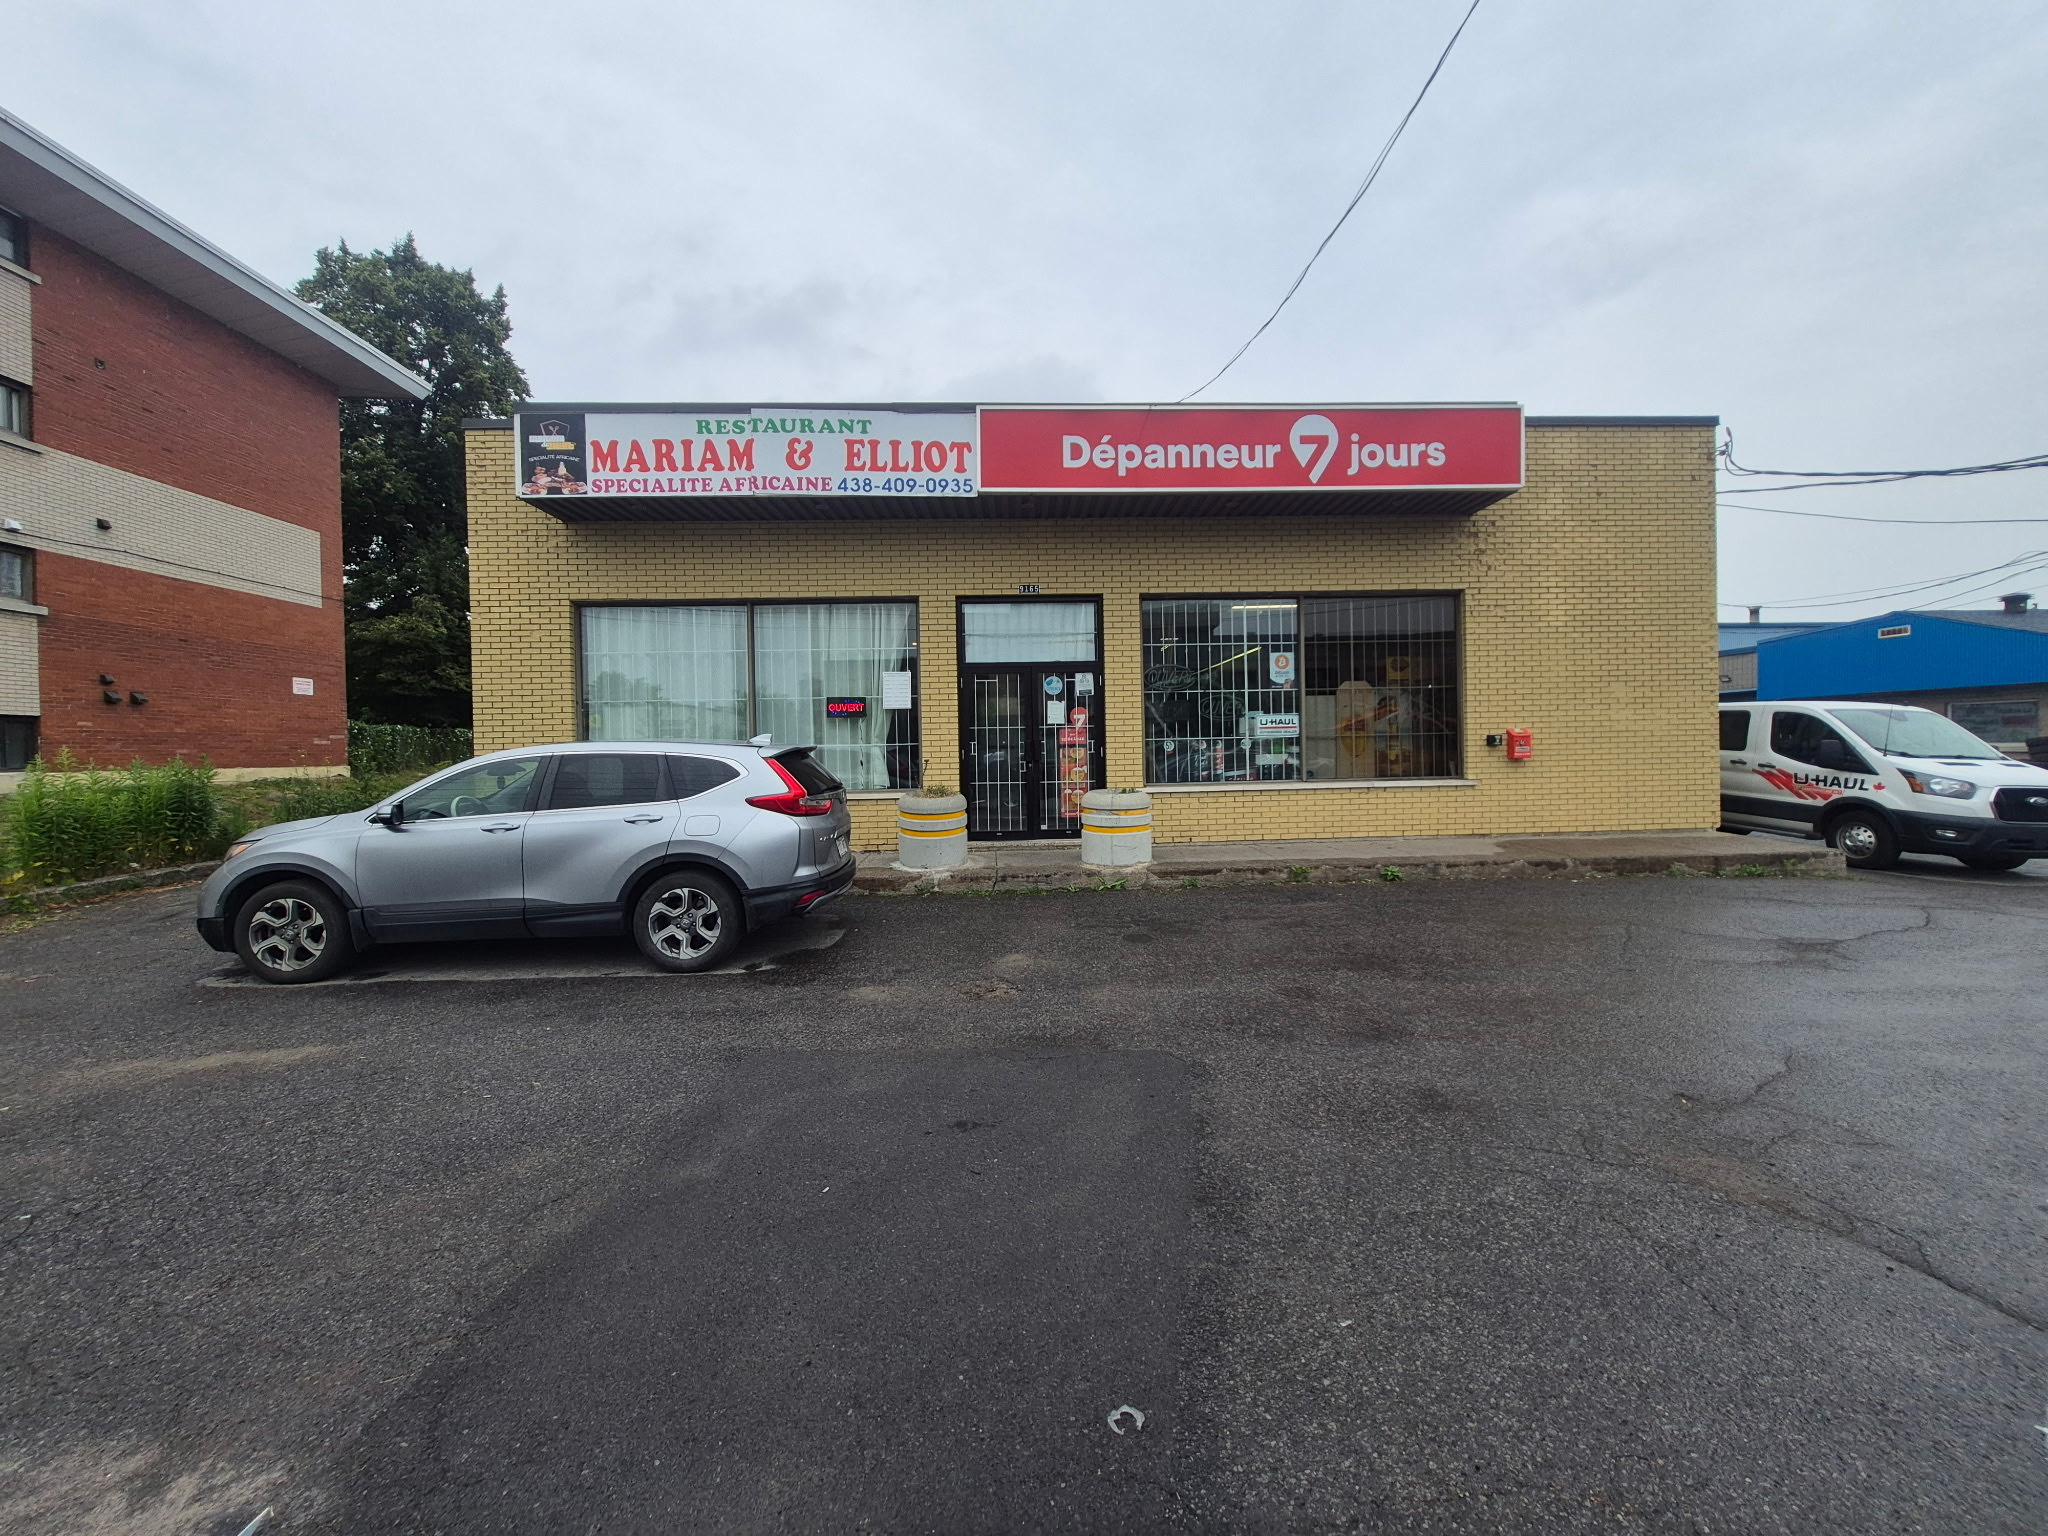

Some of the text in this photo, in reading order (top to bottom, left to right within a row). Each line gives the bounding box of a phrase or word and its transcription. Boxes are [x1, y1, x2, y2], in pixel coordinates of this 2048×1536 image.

[696, 418, 872, 434] RESTAURANT
[590, 437, 973, 474] MARIAM & ELLIOT
[1062, 434, 1281, 477] Dépanneur
[1347, 432, 1446, 476] jours
[591, 475, 974, 494] SPECIALITE AFRICAINE 438-409-0935
[1019, 585, 1039, 593] 9165
[828, 703, 865, 712] OUVERT
[1259, 718, 1297, 726] U-HAUL
[1793, 772, 1869, 791] U-HAUL
